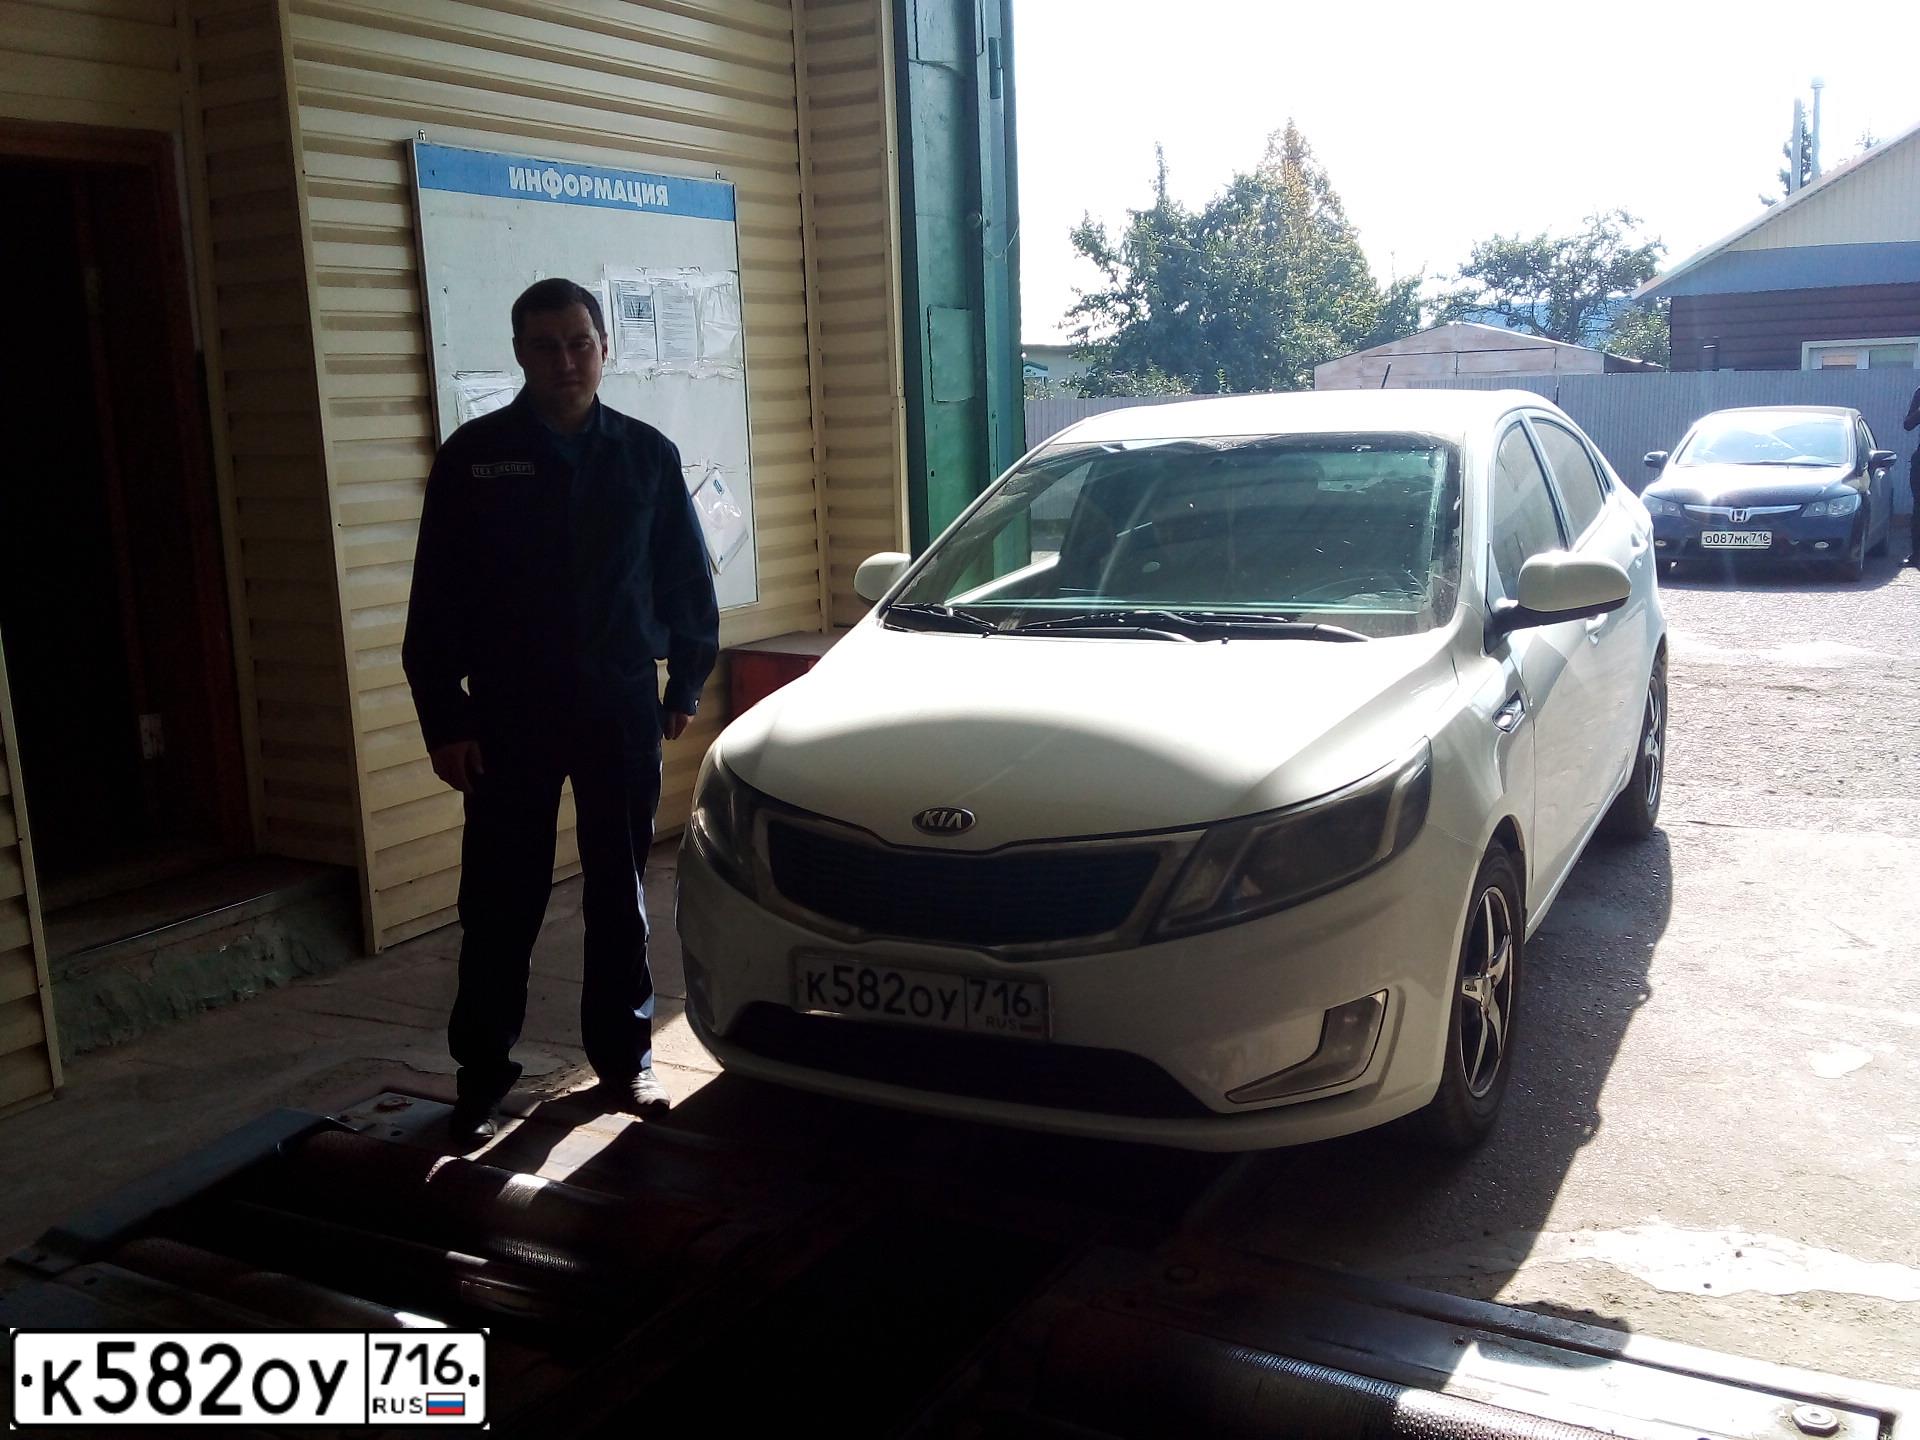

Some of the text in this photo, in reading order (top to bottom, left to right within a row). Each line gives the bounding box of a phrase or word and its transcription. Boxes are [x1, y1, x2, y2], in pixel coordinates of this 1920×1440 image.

[508, 166, 669, 208] ИНФОРМАЦИЯ
[1751, 532, 1768, 542] 716
[921, 811, 962, 829] KIA
[806, 965, 1032, 1021] К582ОУ 716
[986, 1016, 1018, 1031] RUS
